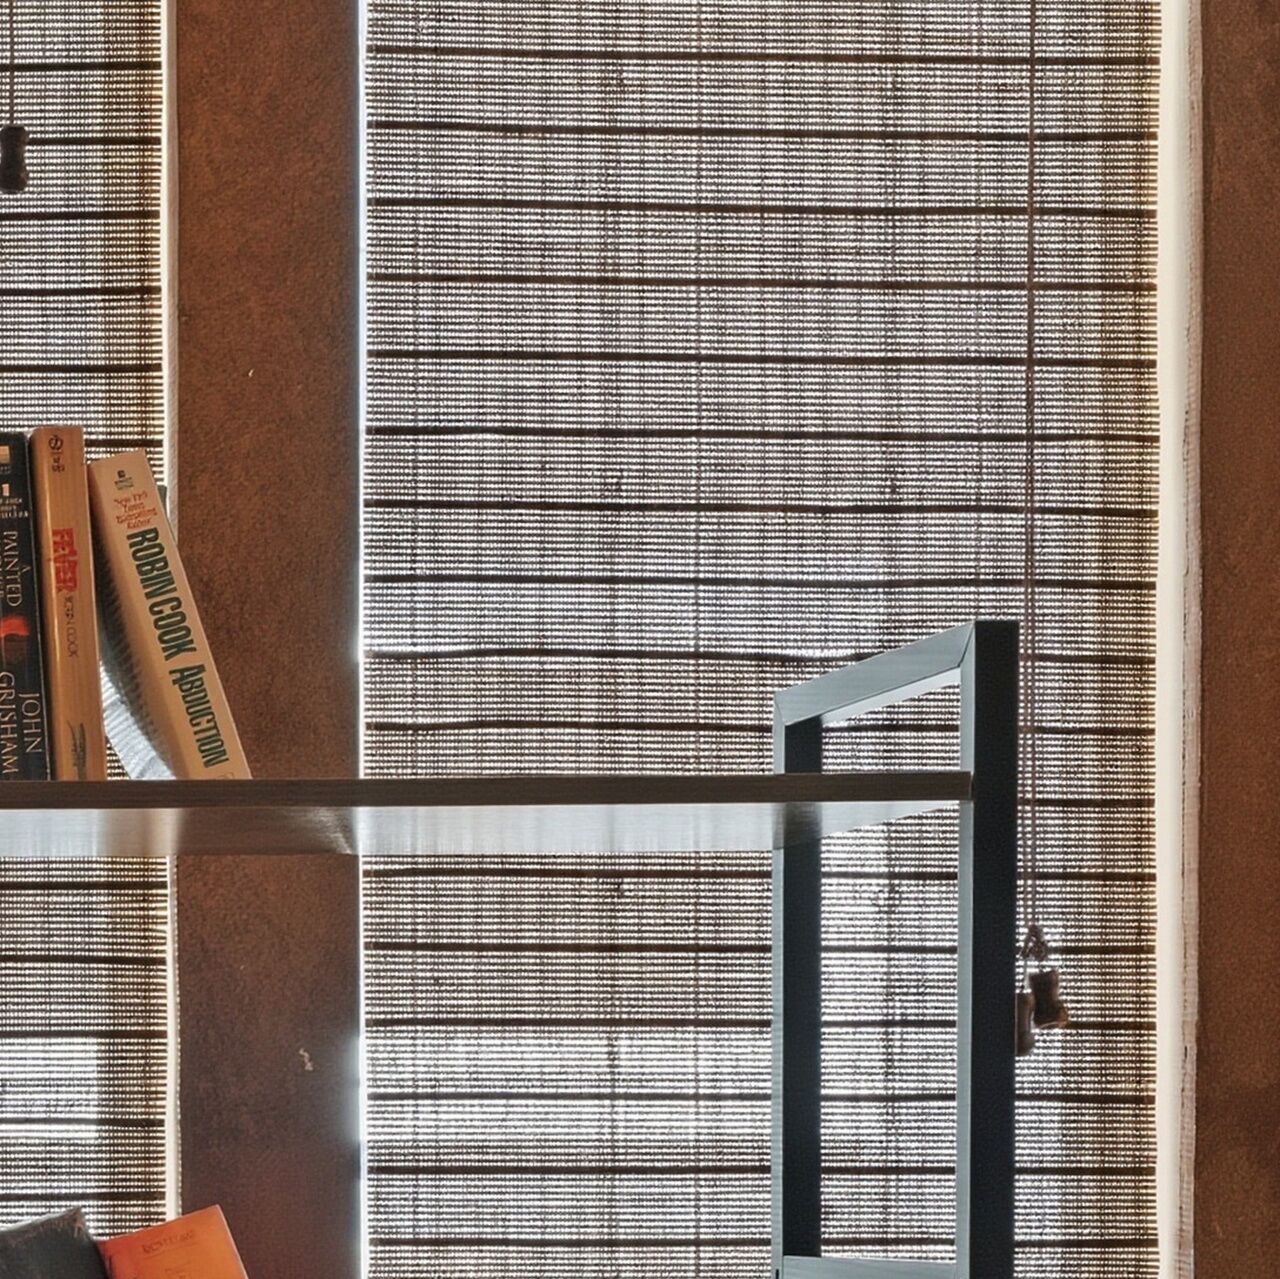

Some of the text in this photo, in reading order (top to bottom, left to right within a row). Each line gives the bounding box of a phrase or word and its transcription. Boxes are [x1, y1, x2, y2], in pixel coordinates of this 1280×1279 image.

[2, 531, 23, 607] PAINTED
[51, 528, 78, 593] FEVER
[126, 527, 178, 601] ROBIN
[148, 596, 197, 662] COOK
[19, 693, 43, 754] JOHN
[168, 664, 230, 768] ABDUCTION
